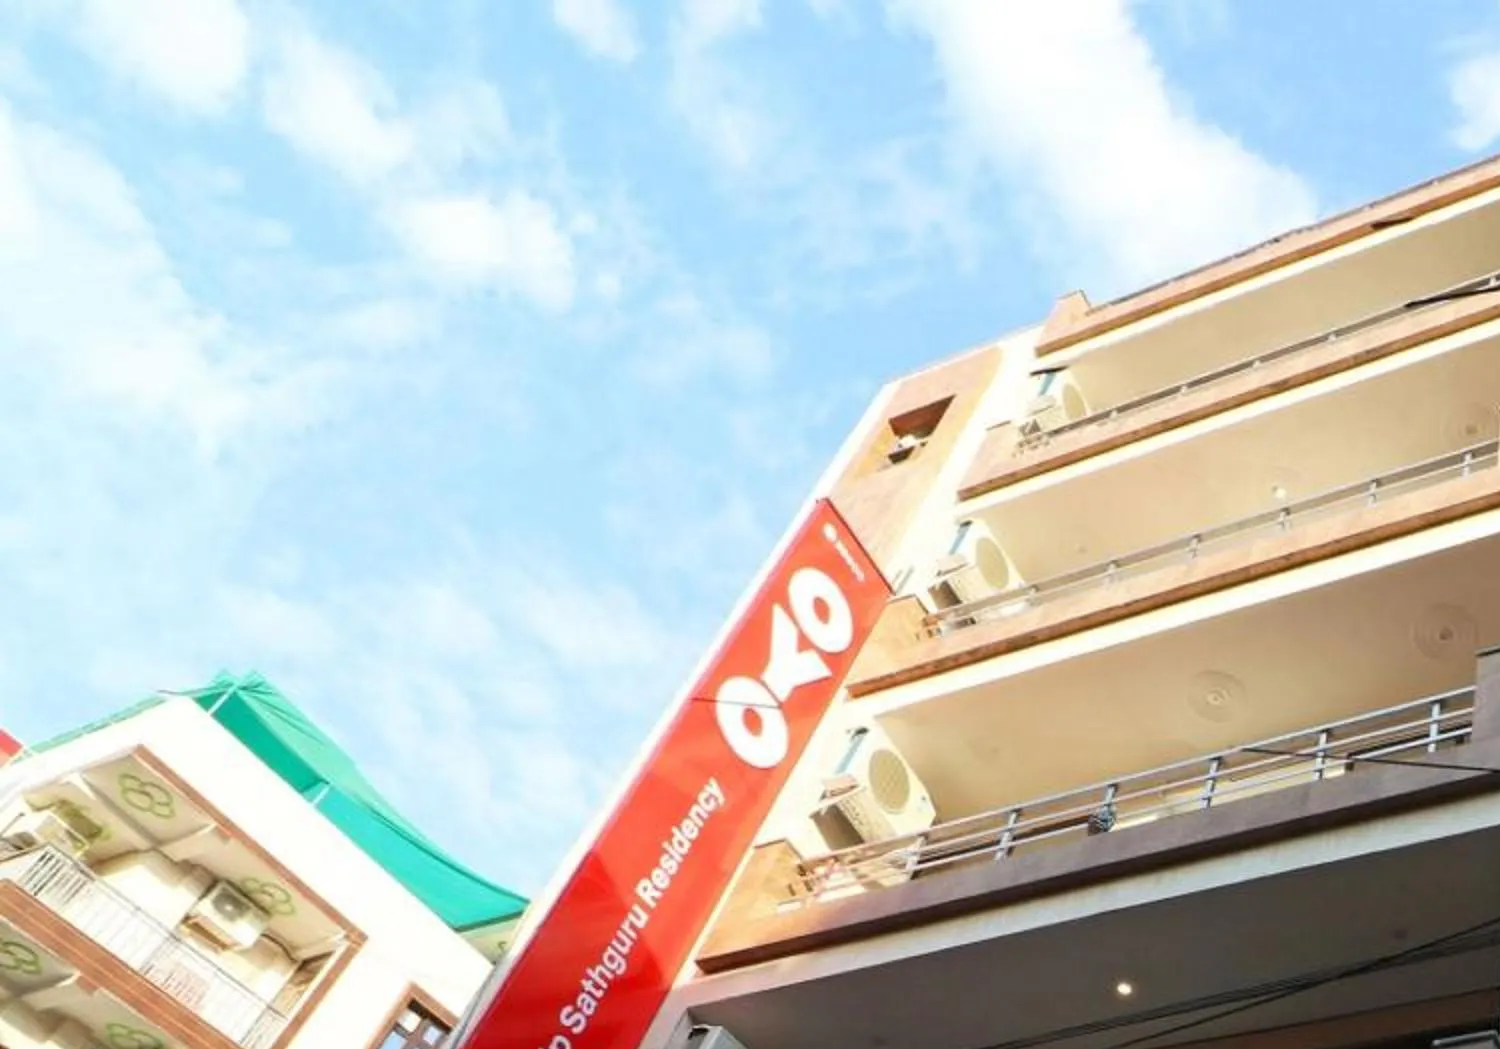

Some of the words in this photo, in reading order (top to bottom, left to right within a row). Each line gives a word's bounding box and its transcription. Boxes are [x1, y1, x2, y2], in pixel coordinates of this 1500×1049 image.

[715, 567, 853, 769] OYO
[560, 904, 648, 1034] Sathguru
[634, 776, 725, 909] Residency
